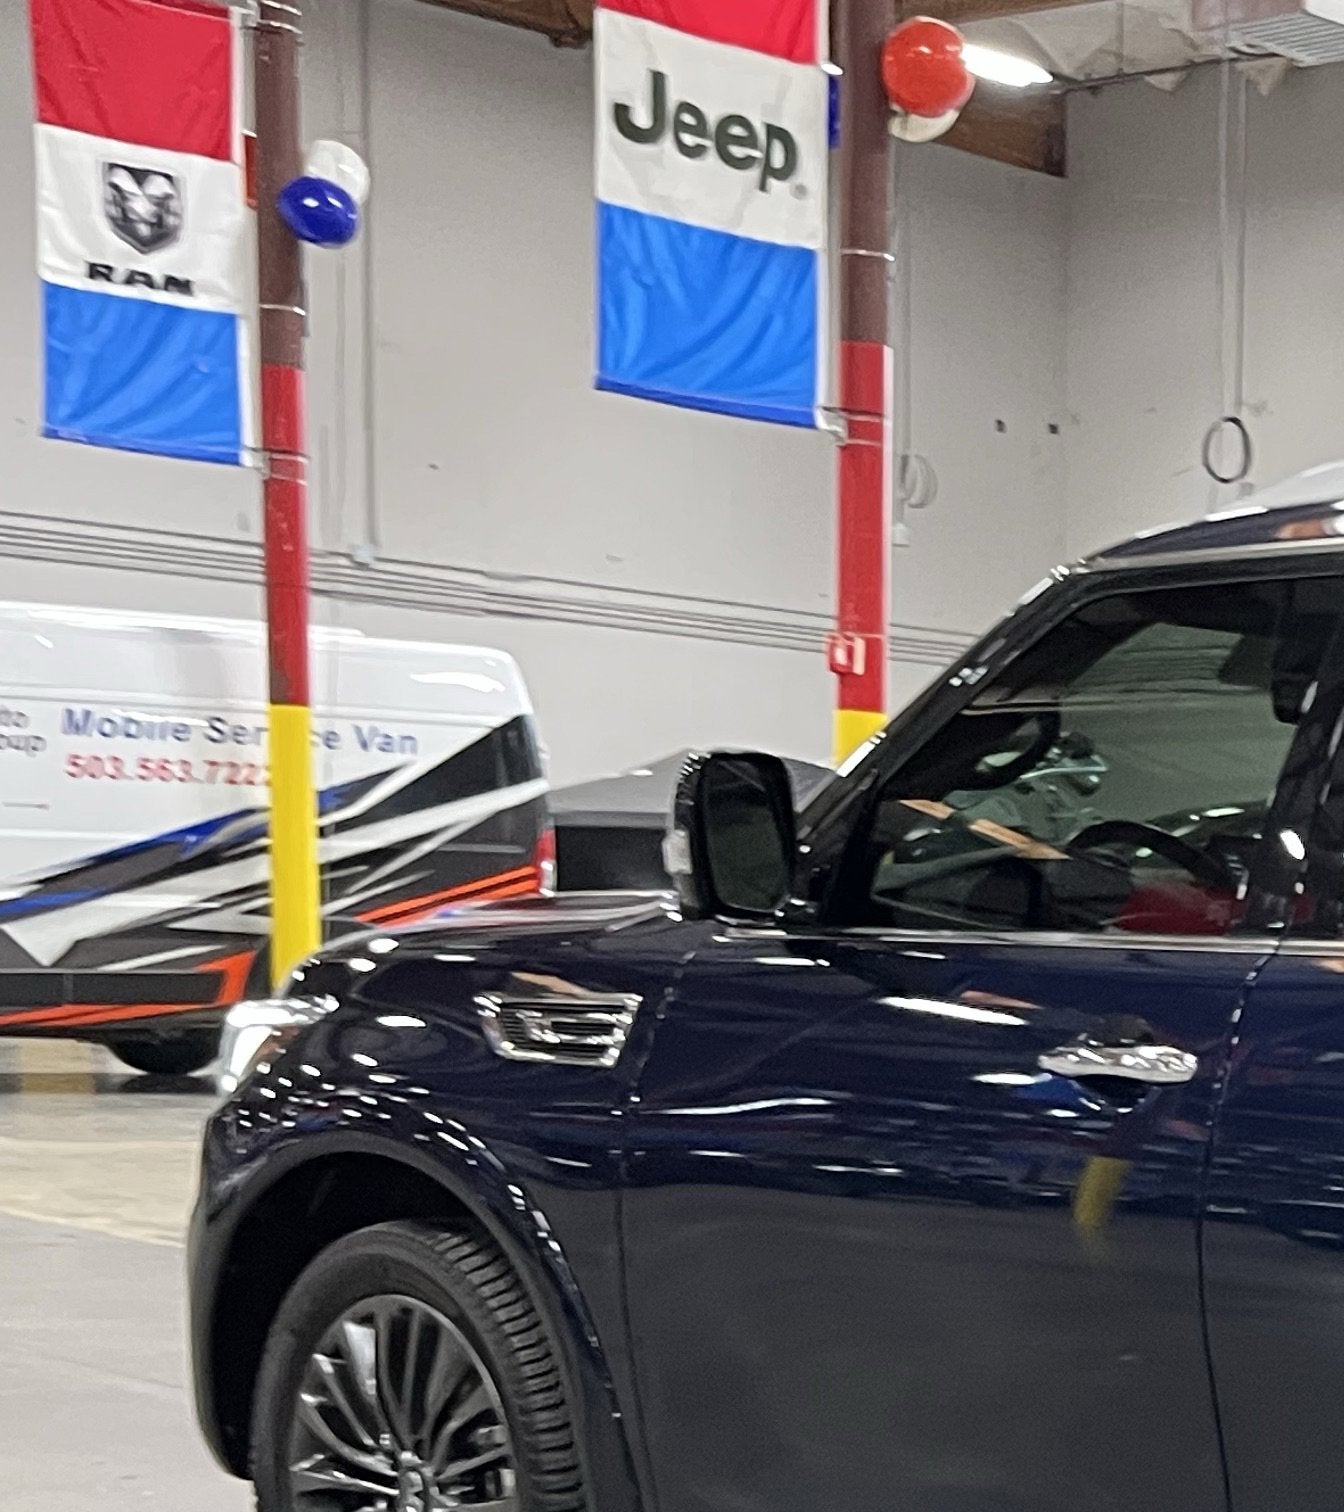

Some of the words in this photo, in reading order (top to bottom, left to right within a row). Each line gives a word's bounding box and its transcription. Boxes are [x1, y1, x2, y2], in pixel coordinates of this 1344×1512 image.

[613, 69, 798, 193] Jeep
[63, 707, 192, 743] Mobile
[203, 716, 341, 750] Sere
[353, 724, 419, 755] Van
[65, 753, 271, 786] 503.563.722
